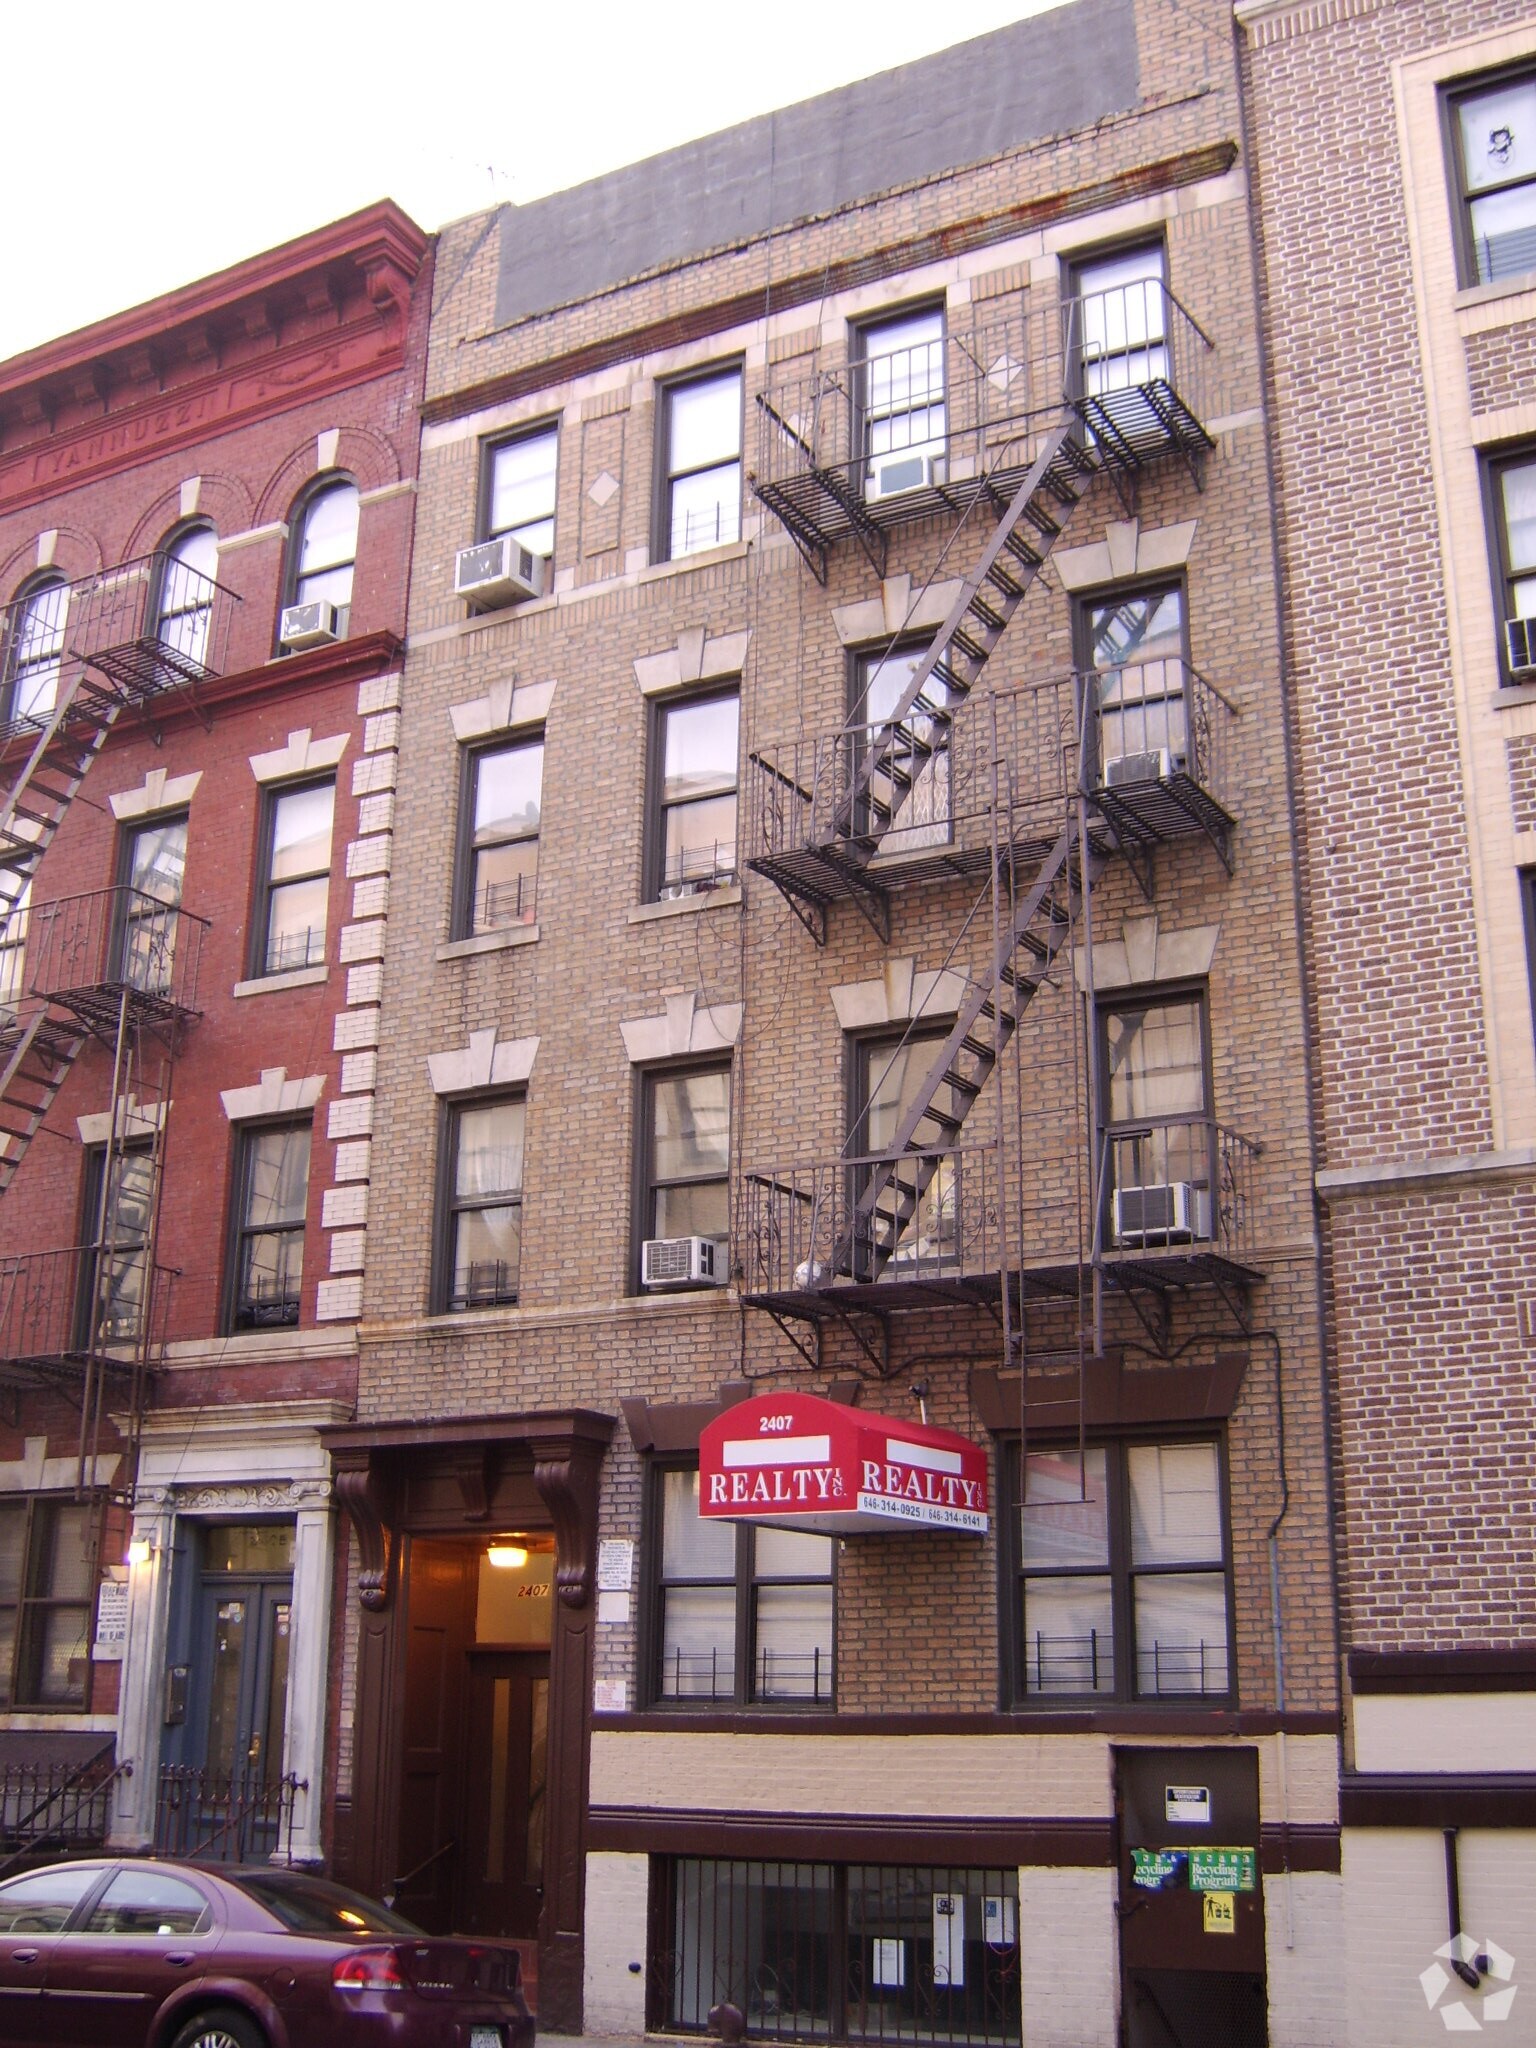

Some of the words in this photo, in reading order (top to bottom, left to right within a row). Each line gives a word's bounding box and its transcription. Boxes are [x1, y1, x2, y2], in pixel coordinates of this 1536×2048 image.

[759, 1415, 793, 1432] 2407
[709, 1468, 832, 1503] REALTY
[861, 1460, 976, 1508] REALTY
[863, 1496, 921, 1518] 646-314-0925
[518, 1584, 548, 1597] 2407
[1192, 1862, 1238, 1877] Recycling
[1192, 1874, 1238, 1889] Program
